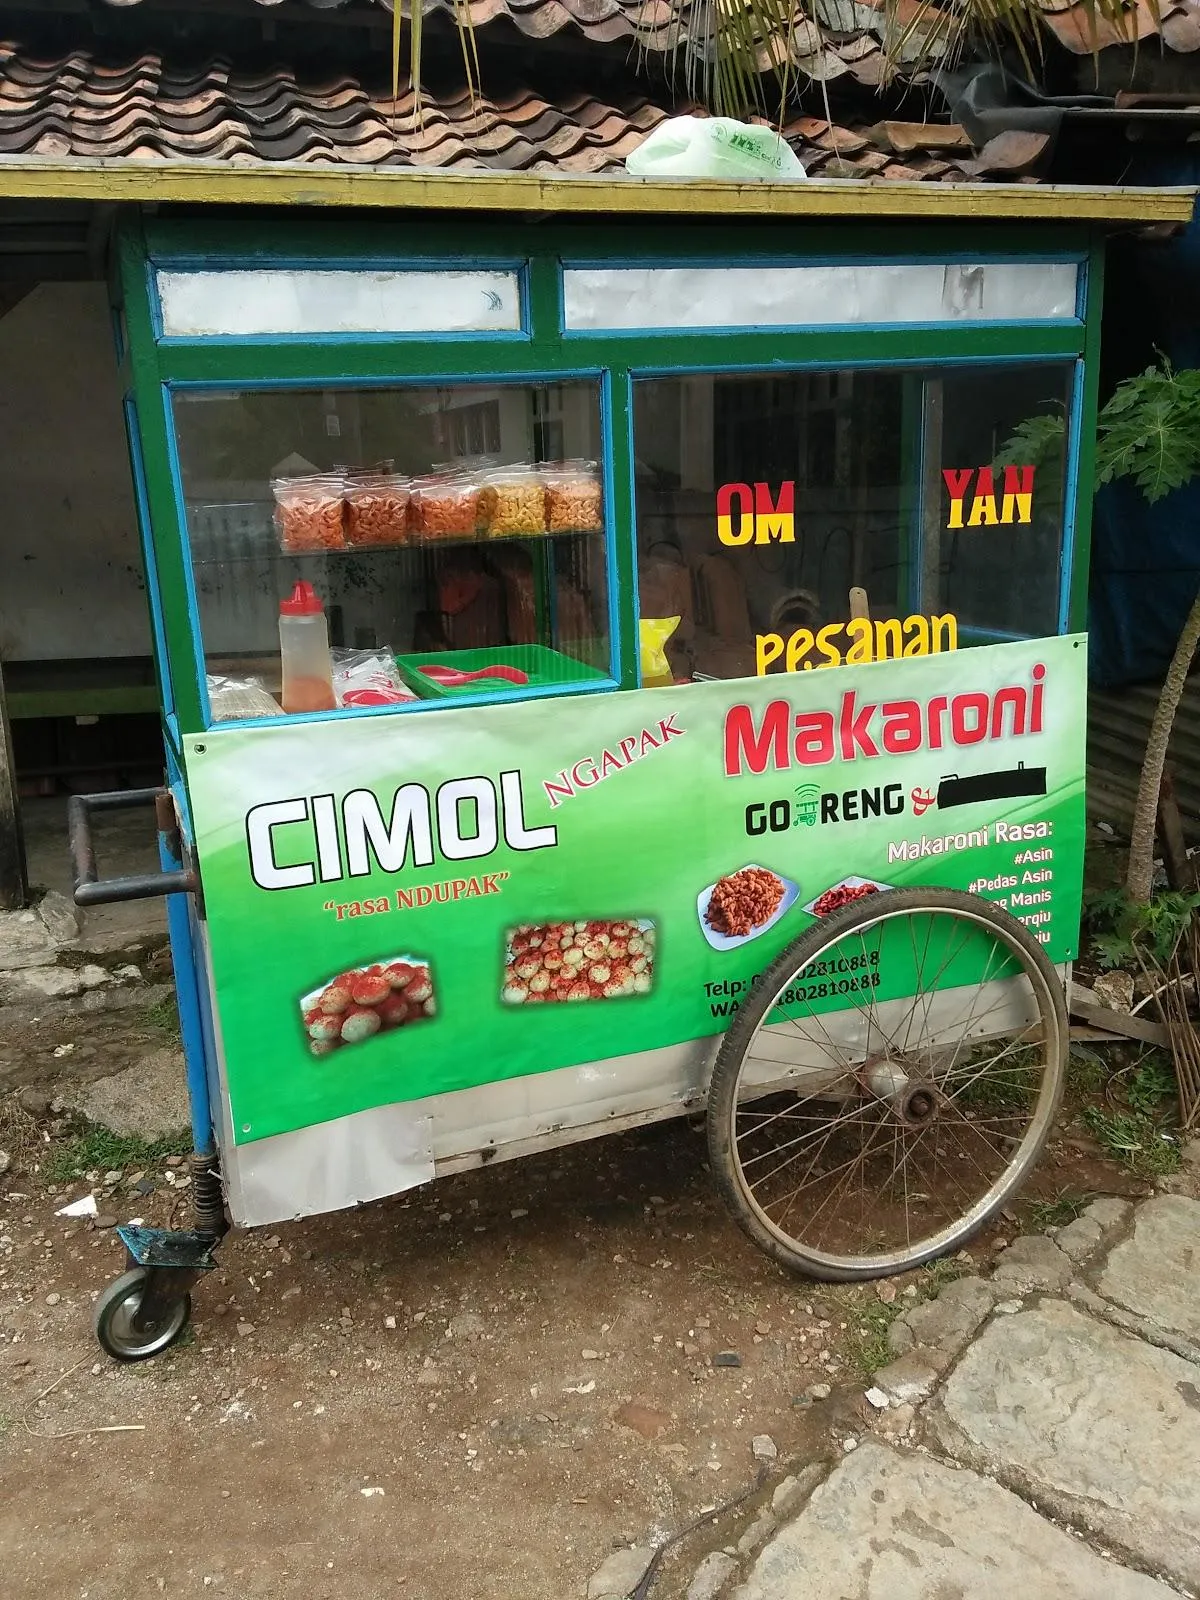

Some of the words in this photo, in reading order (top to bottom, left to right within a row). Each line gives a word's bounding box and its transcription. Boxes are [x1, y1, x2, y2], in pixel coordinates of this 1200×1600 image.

[716, 480, 796, 546] OM
[942, 464, 1035, 528] YAN
[755, 612, 958, 677] pesanan
[722, 662, 1047, 778] Makaroni
[542, 712, 687, 809] NGAPAK
[245, 769, 558, 891] CIMOL
[887, 825, 989, 864] Makaroni
[994, 820, 1054, 844] Rasa:
[1013, 848, 1053, 865] #Asin
[968, 875, 1017, 895] #Pedas
[1021, 869, 1053, 885] Asin
[1011, 890, 1052, 907] Manis
[704, 980, 747, 998] Telp:
